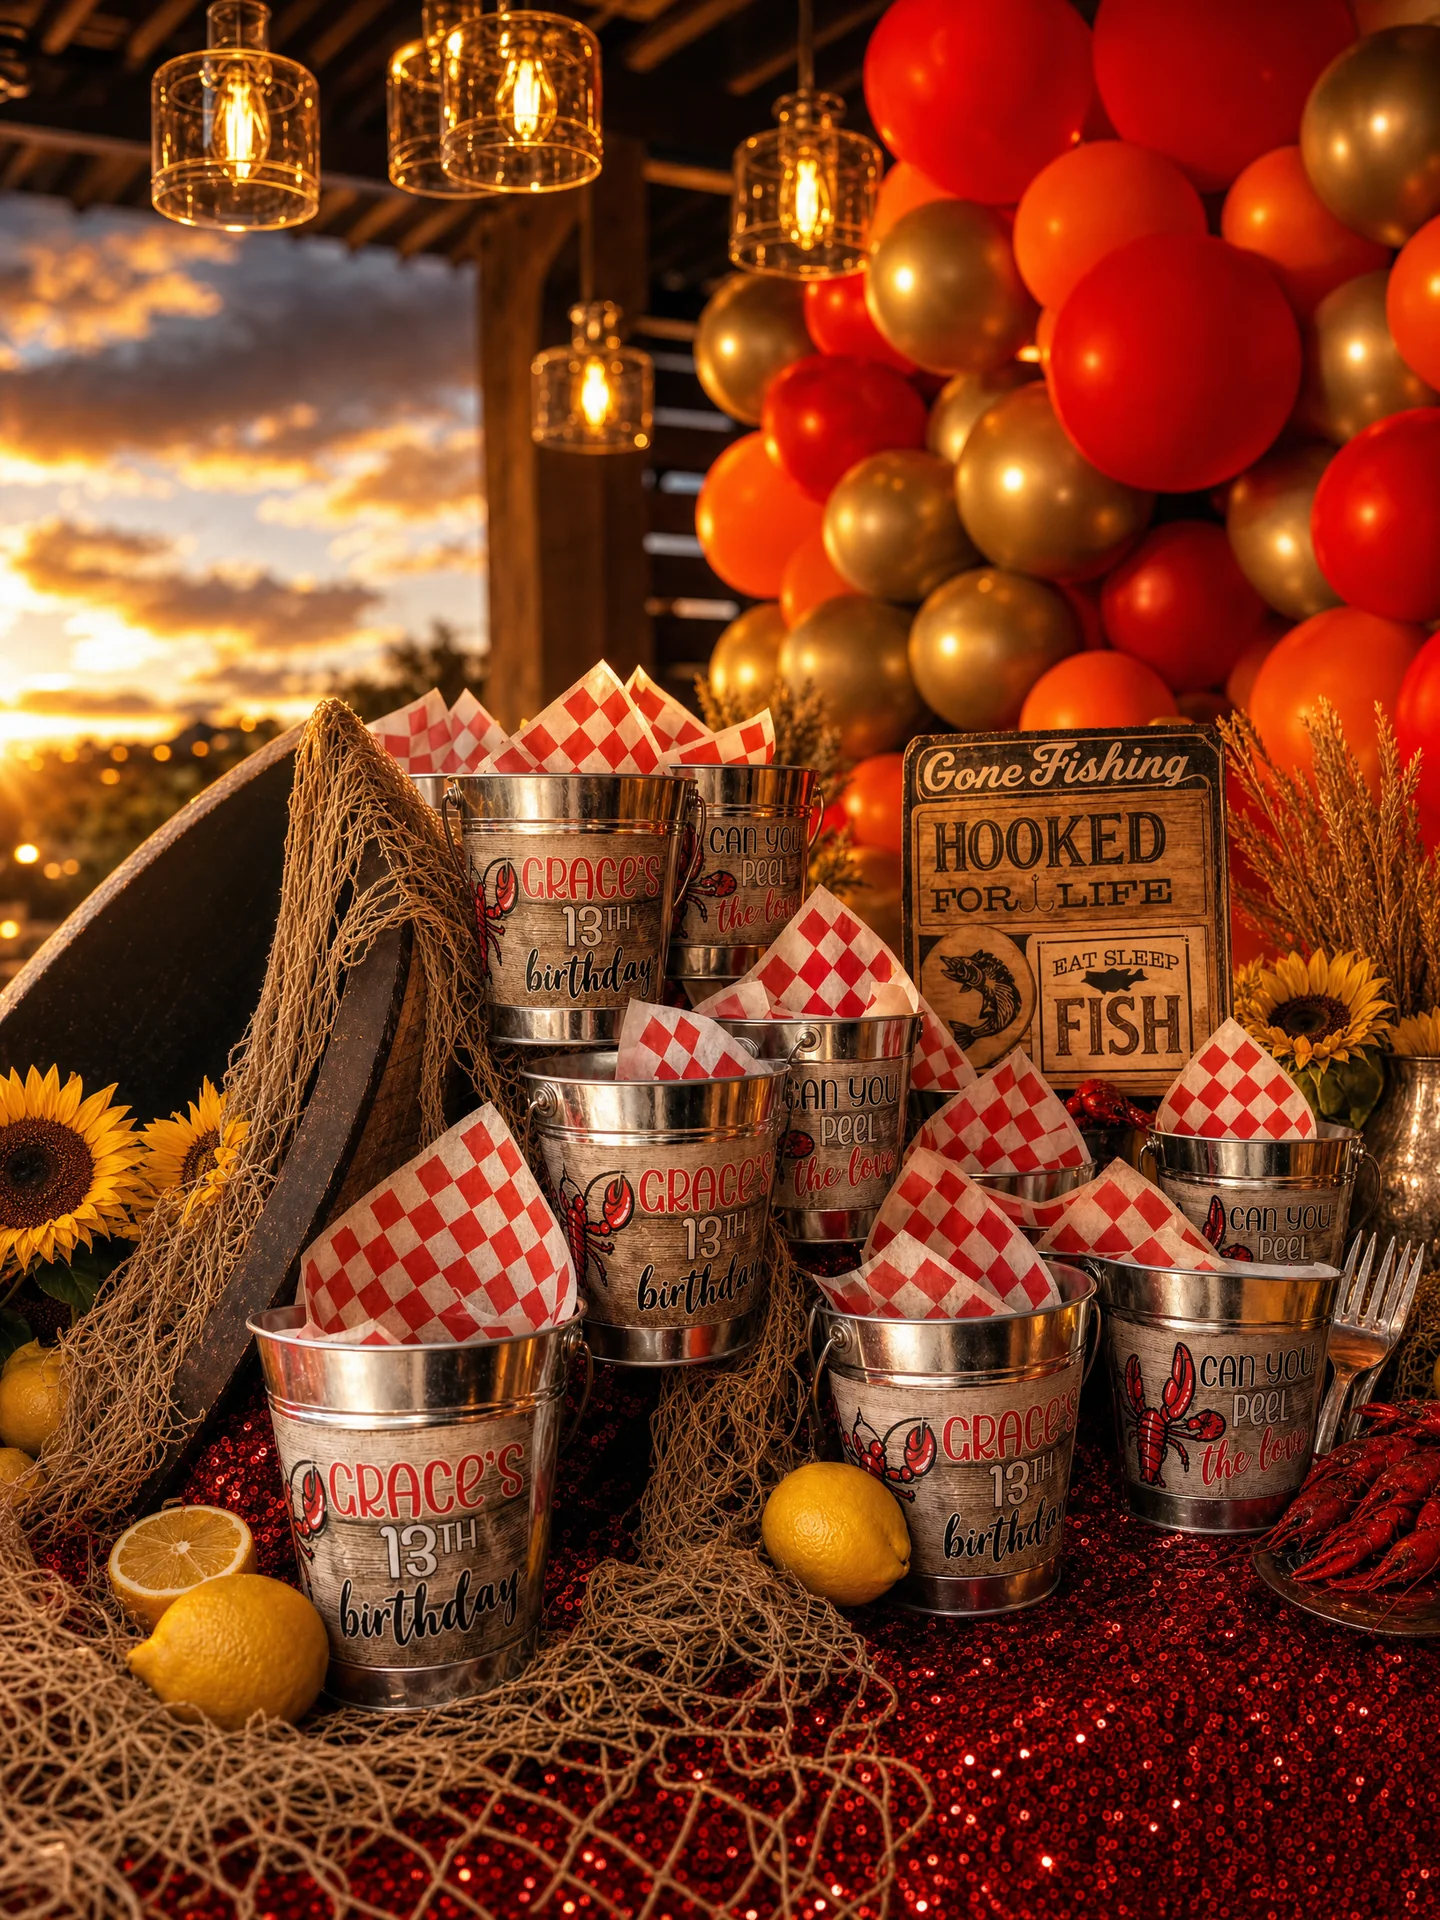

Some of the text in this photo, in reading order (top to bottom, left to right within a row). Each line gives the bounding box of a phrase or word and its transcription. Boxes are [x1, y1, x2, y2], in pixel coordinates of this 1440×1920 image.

[924, 741, 1190, 793] Gone Fishing
[934, 811, 1166, 873] HOOKED
[716, 895, 760, 933] the
[931, 879, 1172, 913] FOR LIFE
[562, 905, 631, 947] 13TH
[526, 946, 653, 999] birthday
[1053, 950, 1180, 976] EAT SLEEP
[1055, 995, 1183, 1056] FISH
[791, 1146, 895, 1197] the love
[682, 1210, 747, 1261] 13TH
[989, 1451, 1054, 1508] 13TH
[1199, 1425, 1307, 1487] the love
[379, 1518, 477, 1580] 13TH
[339, 1568, 520, 1648] birthday
